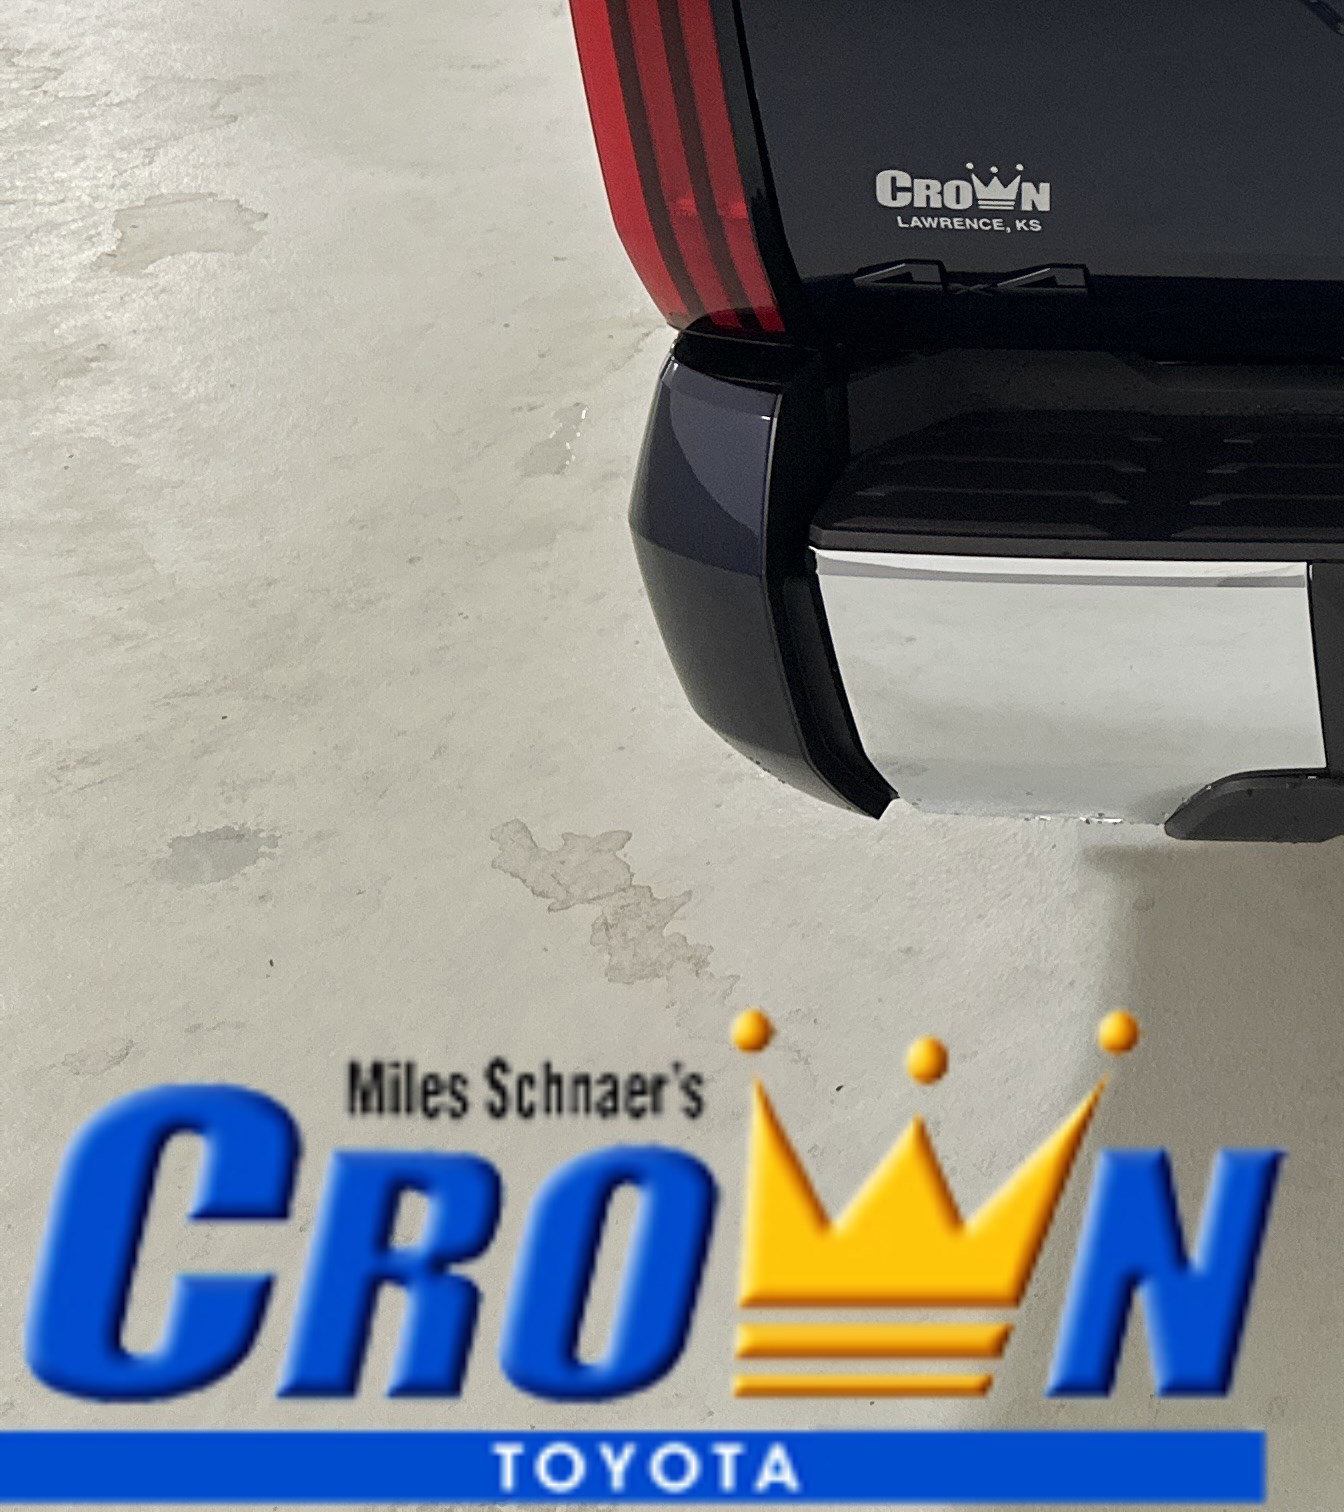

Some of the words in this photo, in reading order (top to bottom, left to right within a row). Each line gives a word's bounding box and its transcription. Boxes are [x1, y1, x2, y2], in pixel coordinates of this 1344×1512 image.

[876, 162, 1051, 212] CROWN
[897, 216, 1011, 233] LAWRENCE,
[1015, 219, 1042, 232] KS
